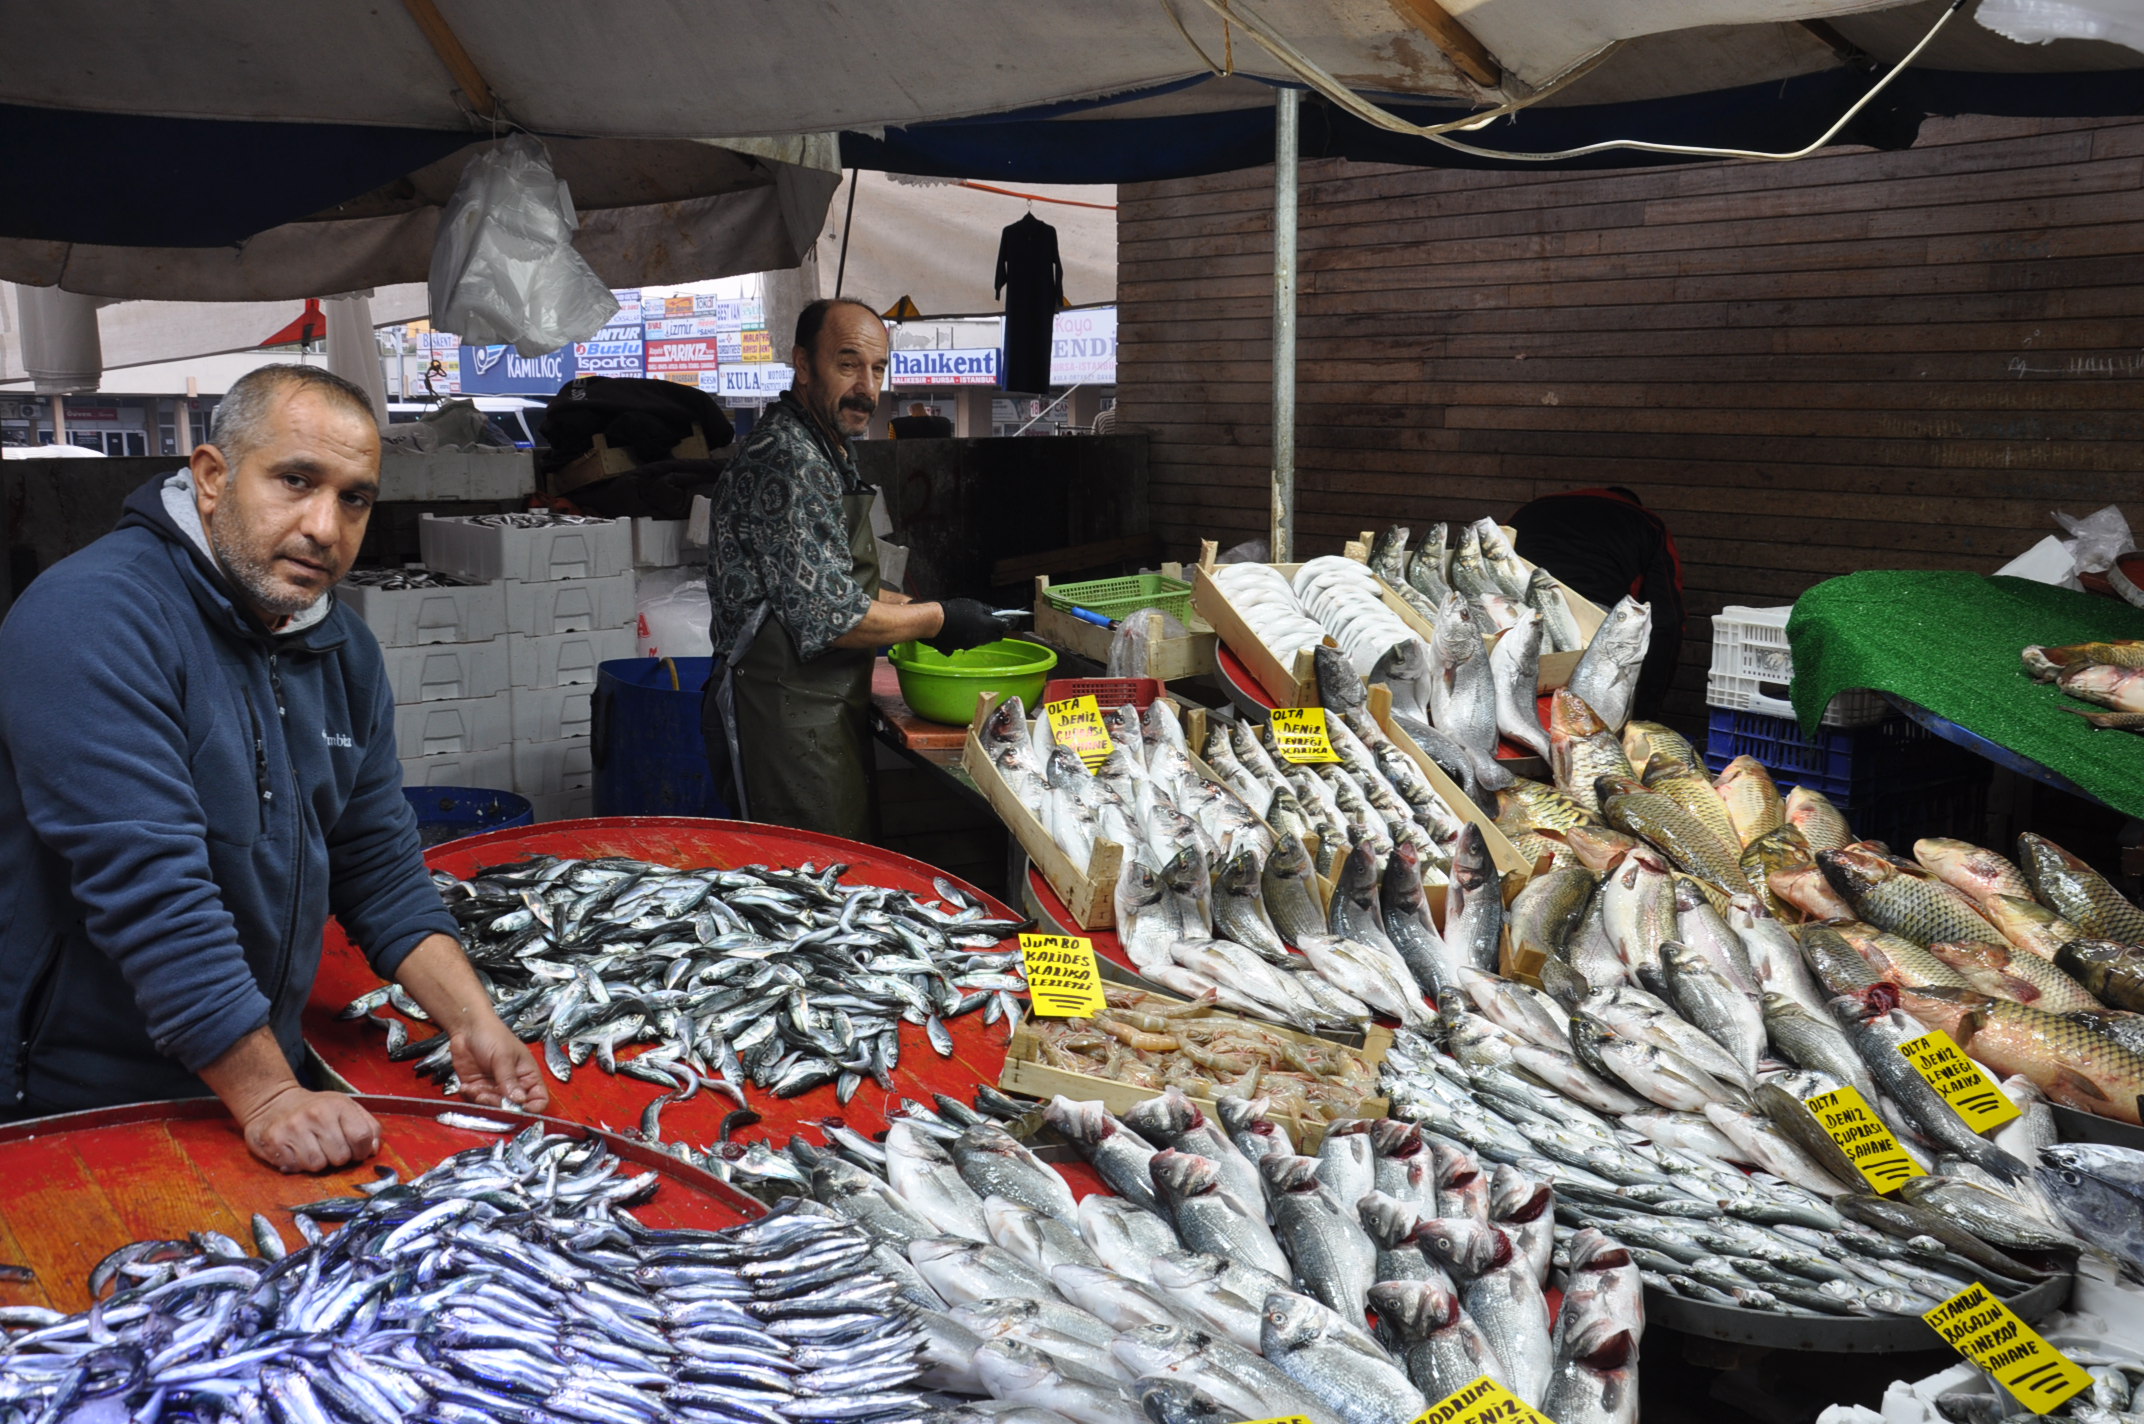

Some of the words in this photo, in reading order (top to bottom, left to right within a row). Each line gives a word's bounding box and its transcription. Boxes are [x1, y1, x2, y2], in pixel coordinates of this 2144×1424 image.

[1055, 316, 1092, 336] Kaya
[587, 342, 640, 355] Buzlu
[577, 356, 640, 371] Isparta
[726, 371, 761, 390] KULA
[1048, 699, 1079, 715] OLTA
[1273, 709, 1303, 721] OLTA
[1022, 937, 1080, 949] JUMBO
[1901, 1037, 1931, 1058] OLTA
[1808, 1093, 1839, 1113] OLTA
[1464, 1400, 1521, 1424] ENİZ
